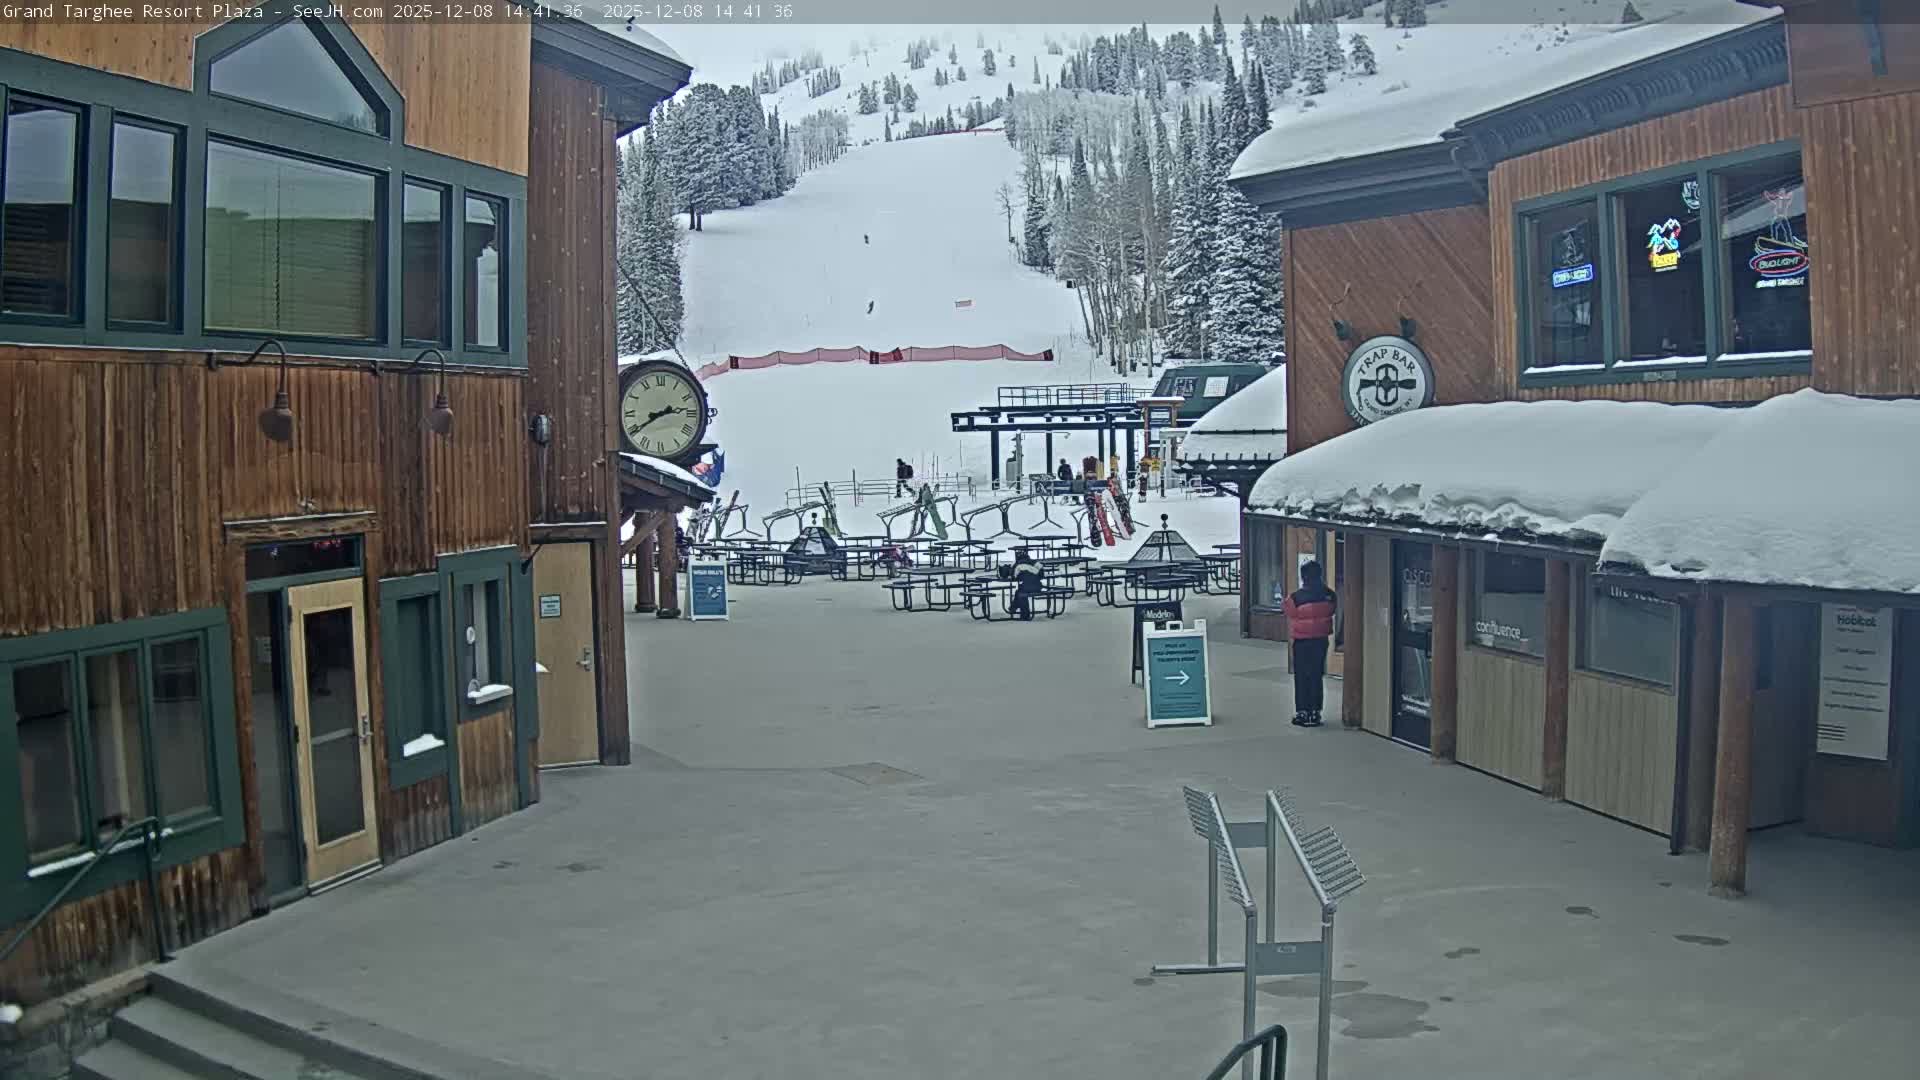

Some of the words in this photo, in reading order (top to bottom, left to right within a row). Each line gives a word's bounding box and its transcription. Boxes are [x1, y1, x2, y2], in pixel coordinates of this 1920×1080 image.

[1358, 348, 1388, 375] TRAP
[1392, 349, 1416, 374] BAR
[1475, 620, 1521, 640] confluence
